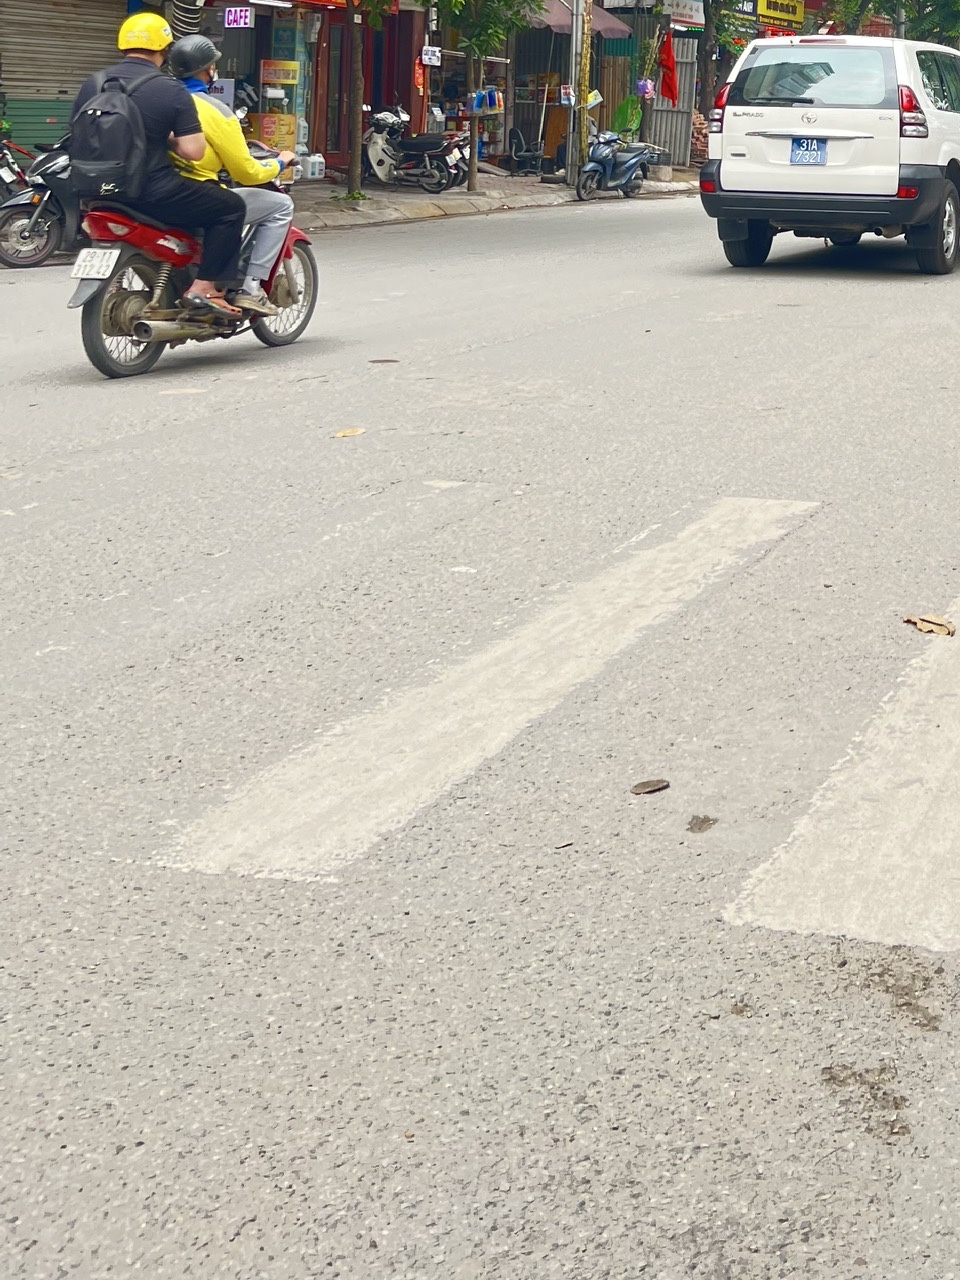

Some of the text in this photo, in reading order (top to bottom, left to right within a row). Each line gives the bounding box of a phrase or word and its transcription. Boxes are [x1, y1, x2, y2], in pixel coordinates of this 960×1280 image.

[226, 8, 249, 26] CAFE
[800, 138, 818, 151] 31A
[794, 151, 821, 163] 7321
